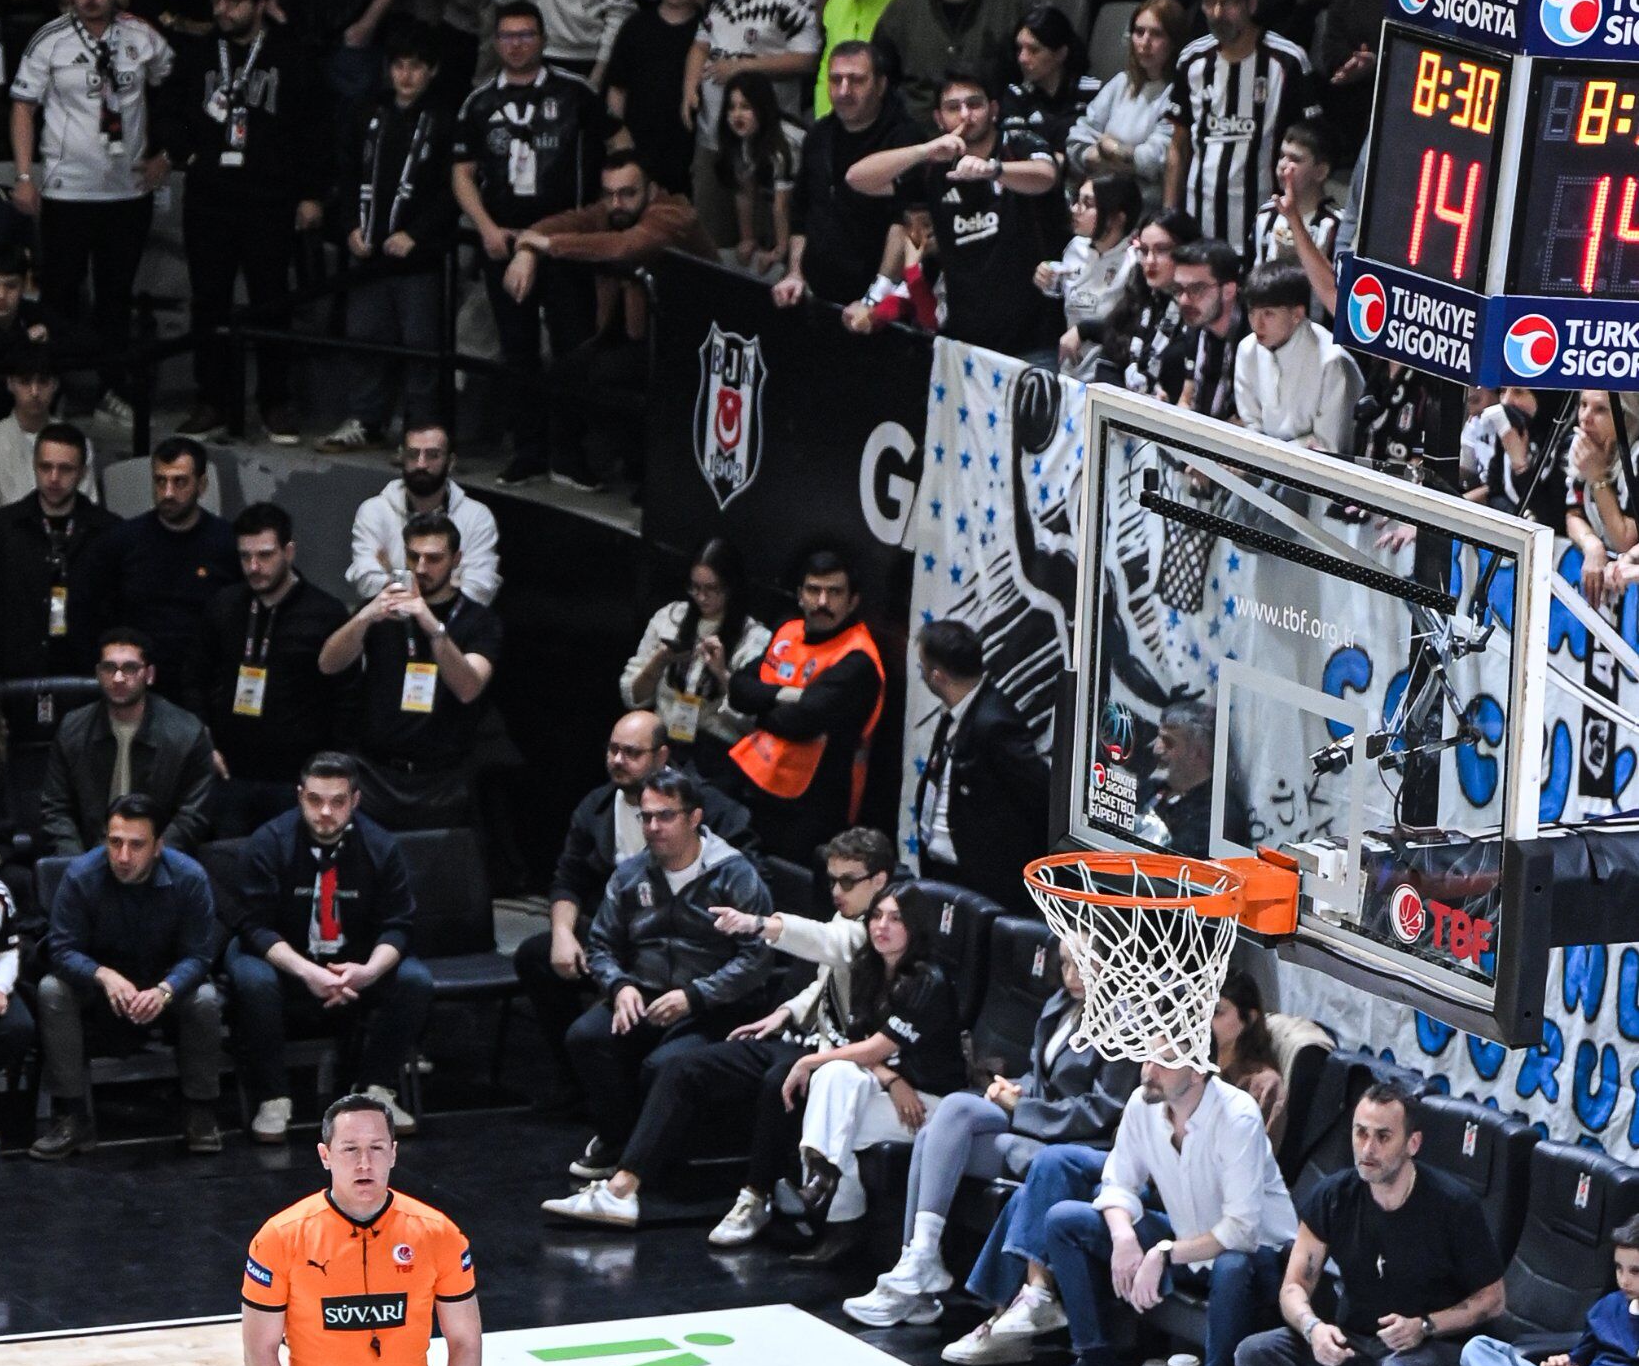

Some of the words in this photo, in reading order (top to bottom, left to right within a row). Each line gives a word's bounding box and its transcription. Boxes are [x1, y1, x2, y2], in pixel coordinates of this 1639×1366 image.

[1412, 50, 1502, 136] 8:30
[1205, 114, 1256, 136] beko
[953, 211, 1000, 235] beko
[1408, 148, 1482, 280] 14
[711, 342, 756, 387] BJK
[708, 452, 745, 484] 1903
[859, 421, 918, 552] G
[1234, 594, 1356, 650] www.tbf.org.tr
[1430, 899, 1493, 967] TBF
[325, 1299, 404, 1326] SÜVARİ
